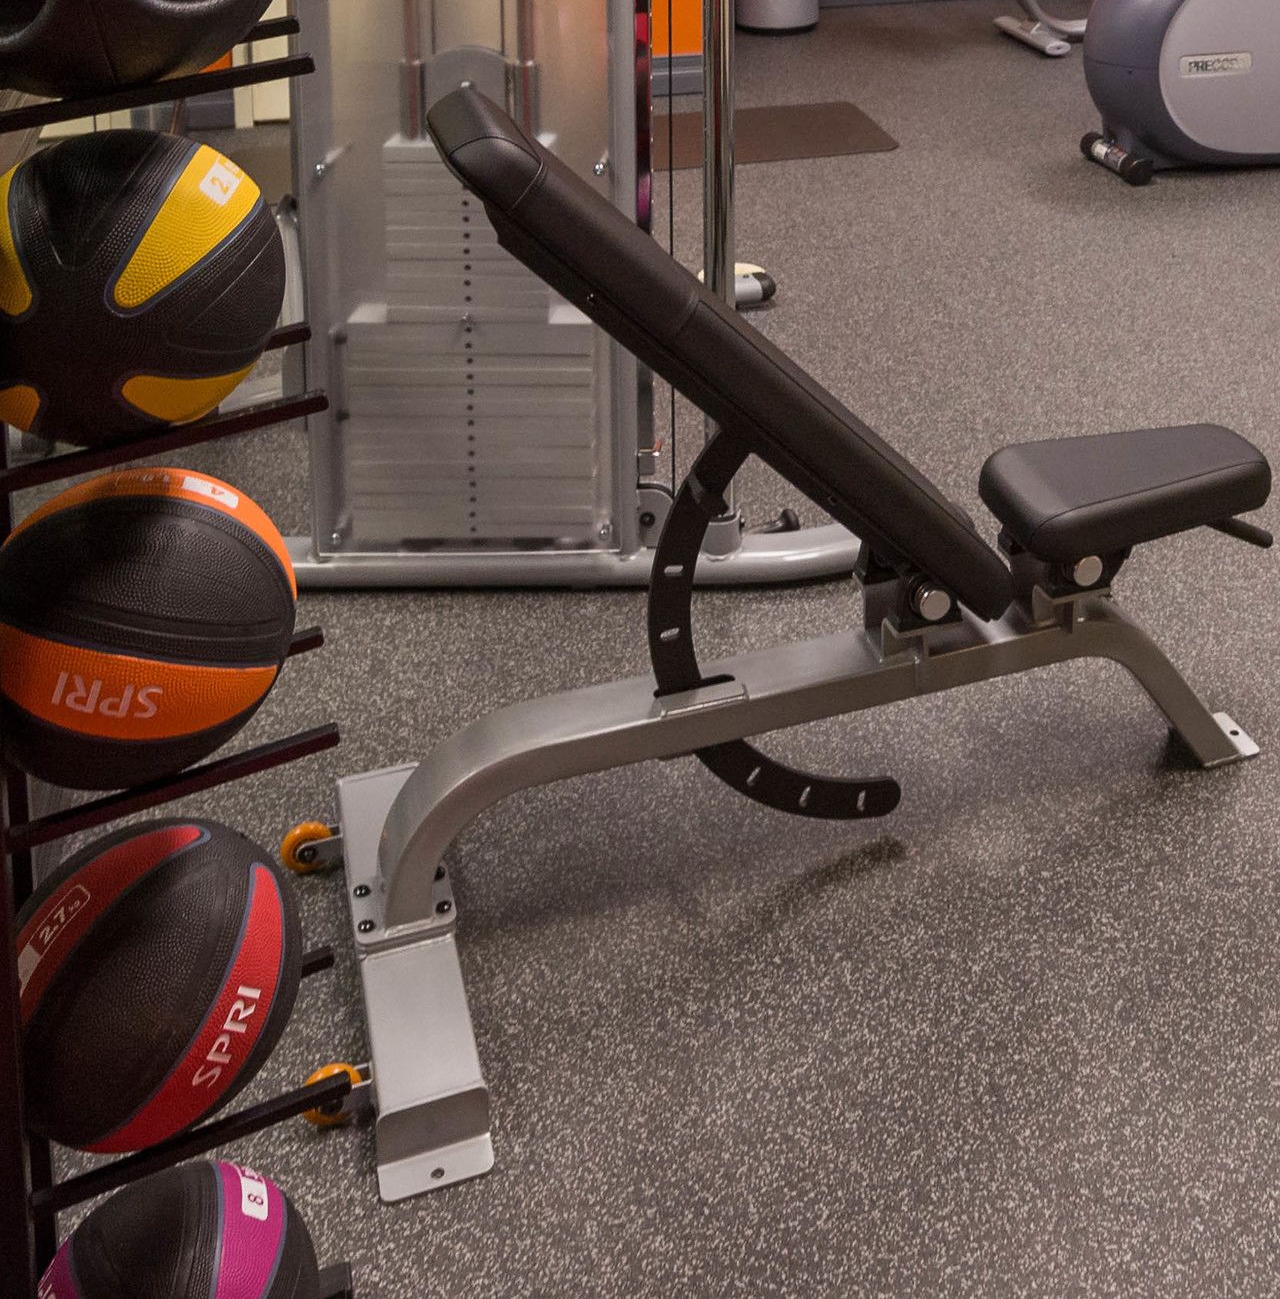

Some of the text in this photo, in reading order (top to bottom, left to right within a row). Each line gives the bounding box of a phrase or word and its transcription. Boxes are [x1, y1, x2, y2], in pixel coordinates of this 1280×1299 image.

[210, 176, 228, 195] 2
[51, 671, 163, 719] SPRI
[39, 905, 66, 945] 2.7
[191, 984, 261, 1088] SPRI
[247, 1193, 264, 1206] 8
